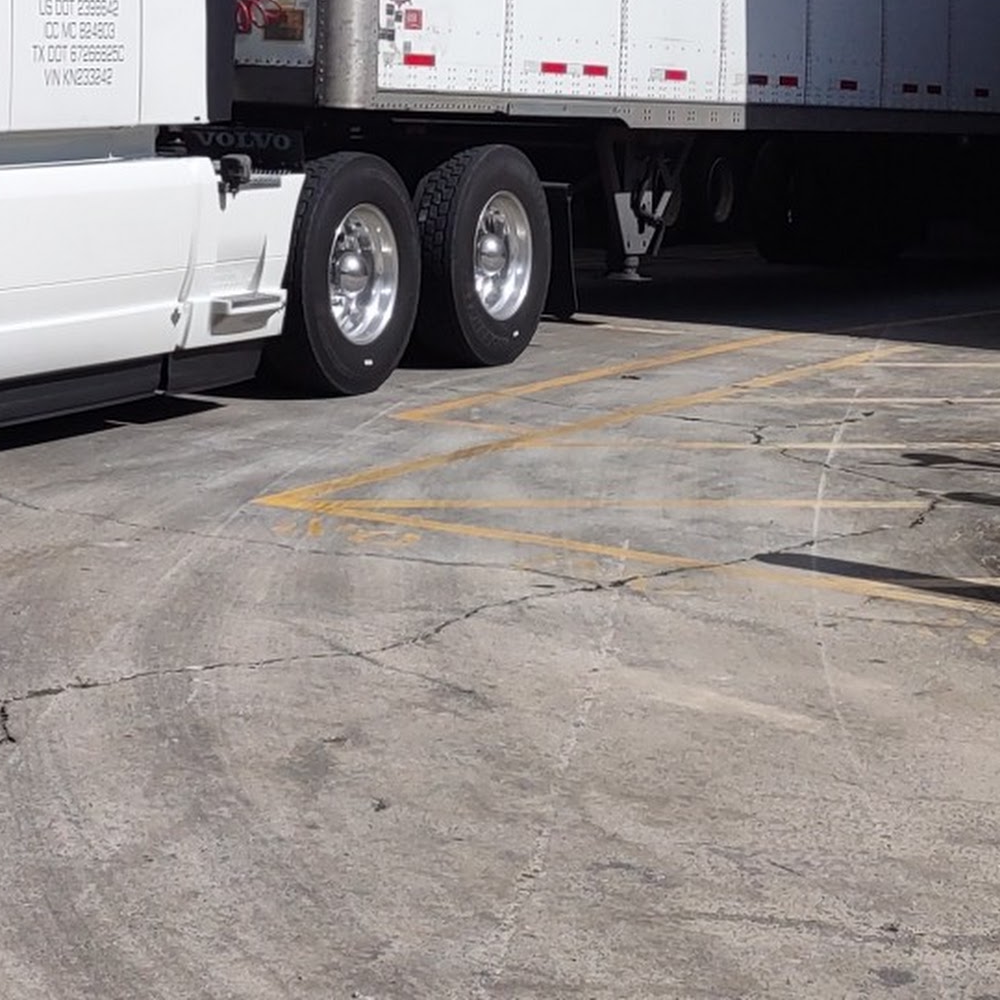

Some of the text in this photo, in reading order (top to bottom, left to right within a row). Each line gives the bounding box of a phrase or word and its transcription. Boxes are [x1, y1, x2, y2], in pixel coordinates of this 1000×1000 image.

[61, 21, 77, 39] MC
[32, 44, 46, 63] TX
[48, 44, 68, 63] DOT
[193, 130, 291, 151] VOLVO
